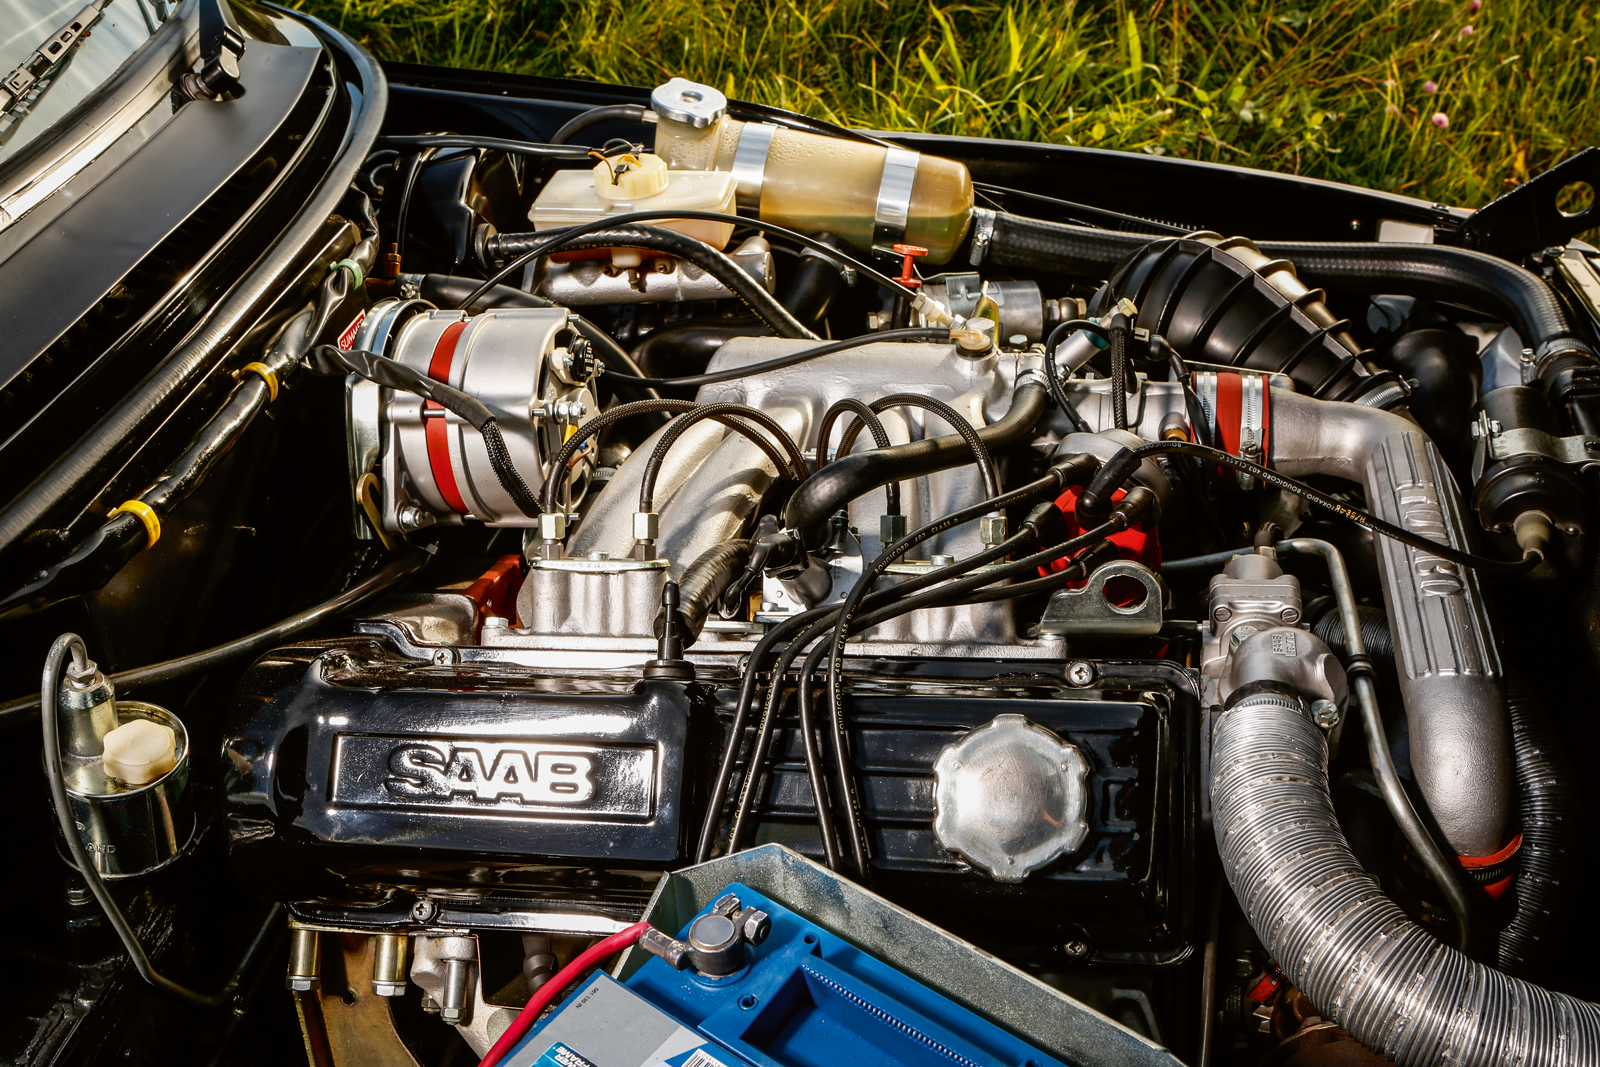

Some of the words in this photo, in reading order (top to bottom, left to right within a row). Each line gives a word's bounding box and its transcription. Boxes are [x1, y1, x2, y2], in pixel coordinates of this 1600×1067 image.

[1225, 456, 1247, 469] CLASS
[1248, 465, 1261, 475] 403
[1262, 472, 1302, 495] BOUGICORD
[930, 520, 951, 534] CLASS
[914, 532, 926, 543] 403
[874, 542, 910, 575] BOUGICORD
[838, 623, 849, 650] CLASS
[834, 657, 842, 674] 403
[758, 682, 775, 735] BOUGICORD
[772, 657, 782, 674] 403
[834, 682, 845, 735] BOUGICORD
[384, 743, 598, 806] SAAB
[554, 1053, 578, 1067] WER
